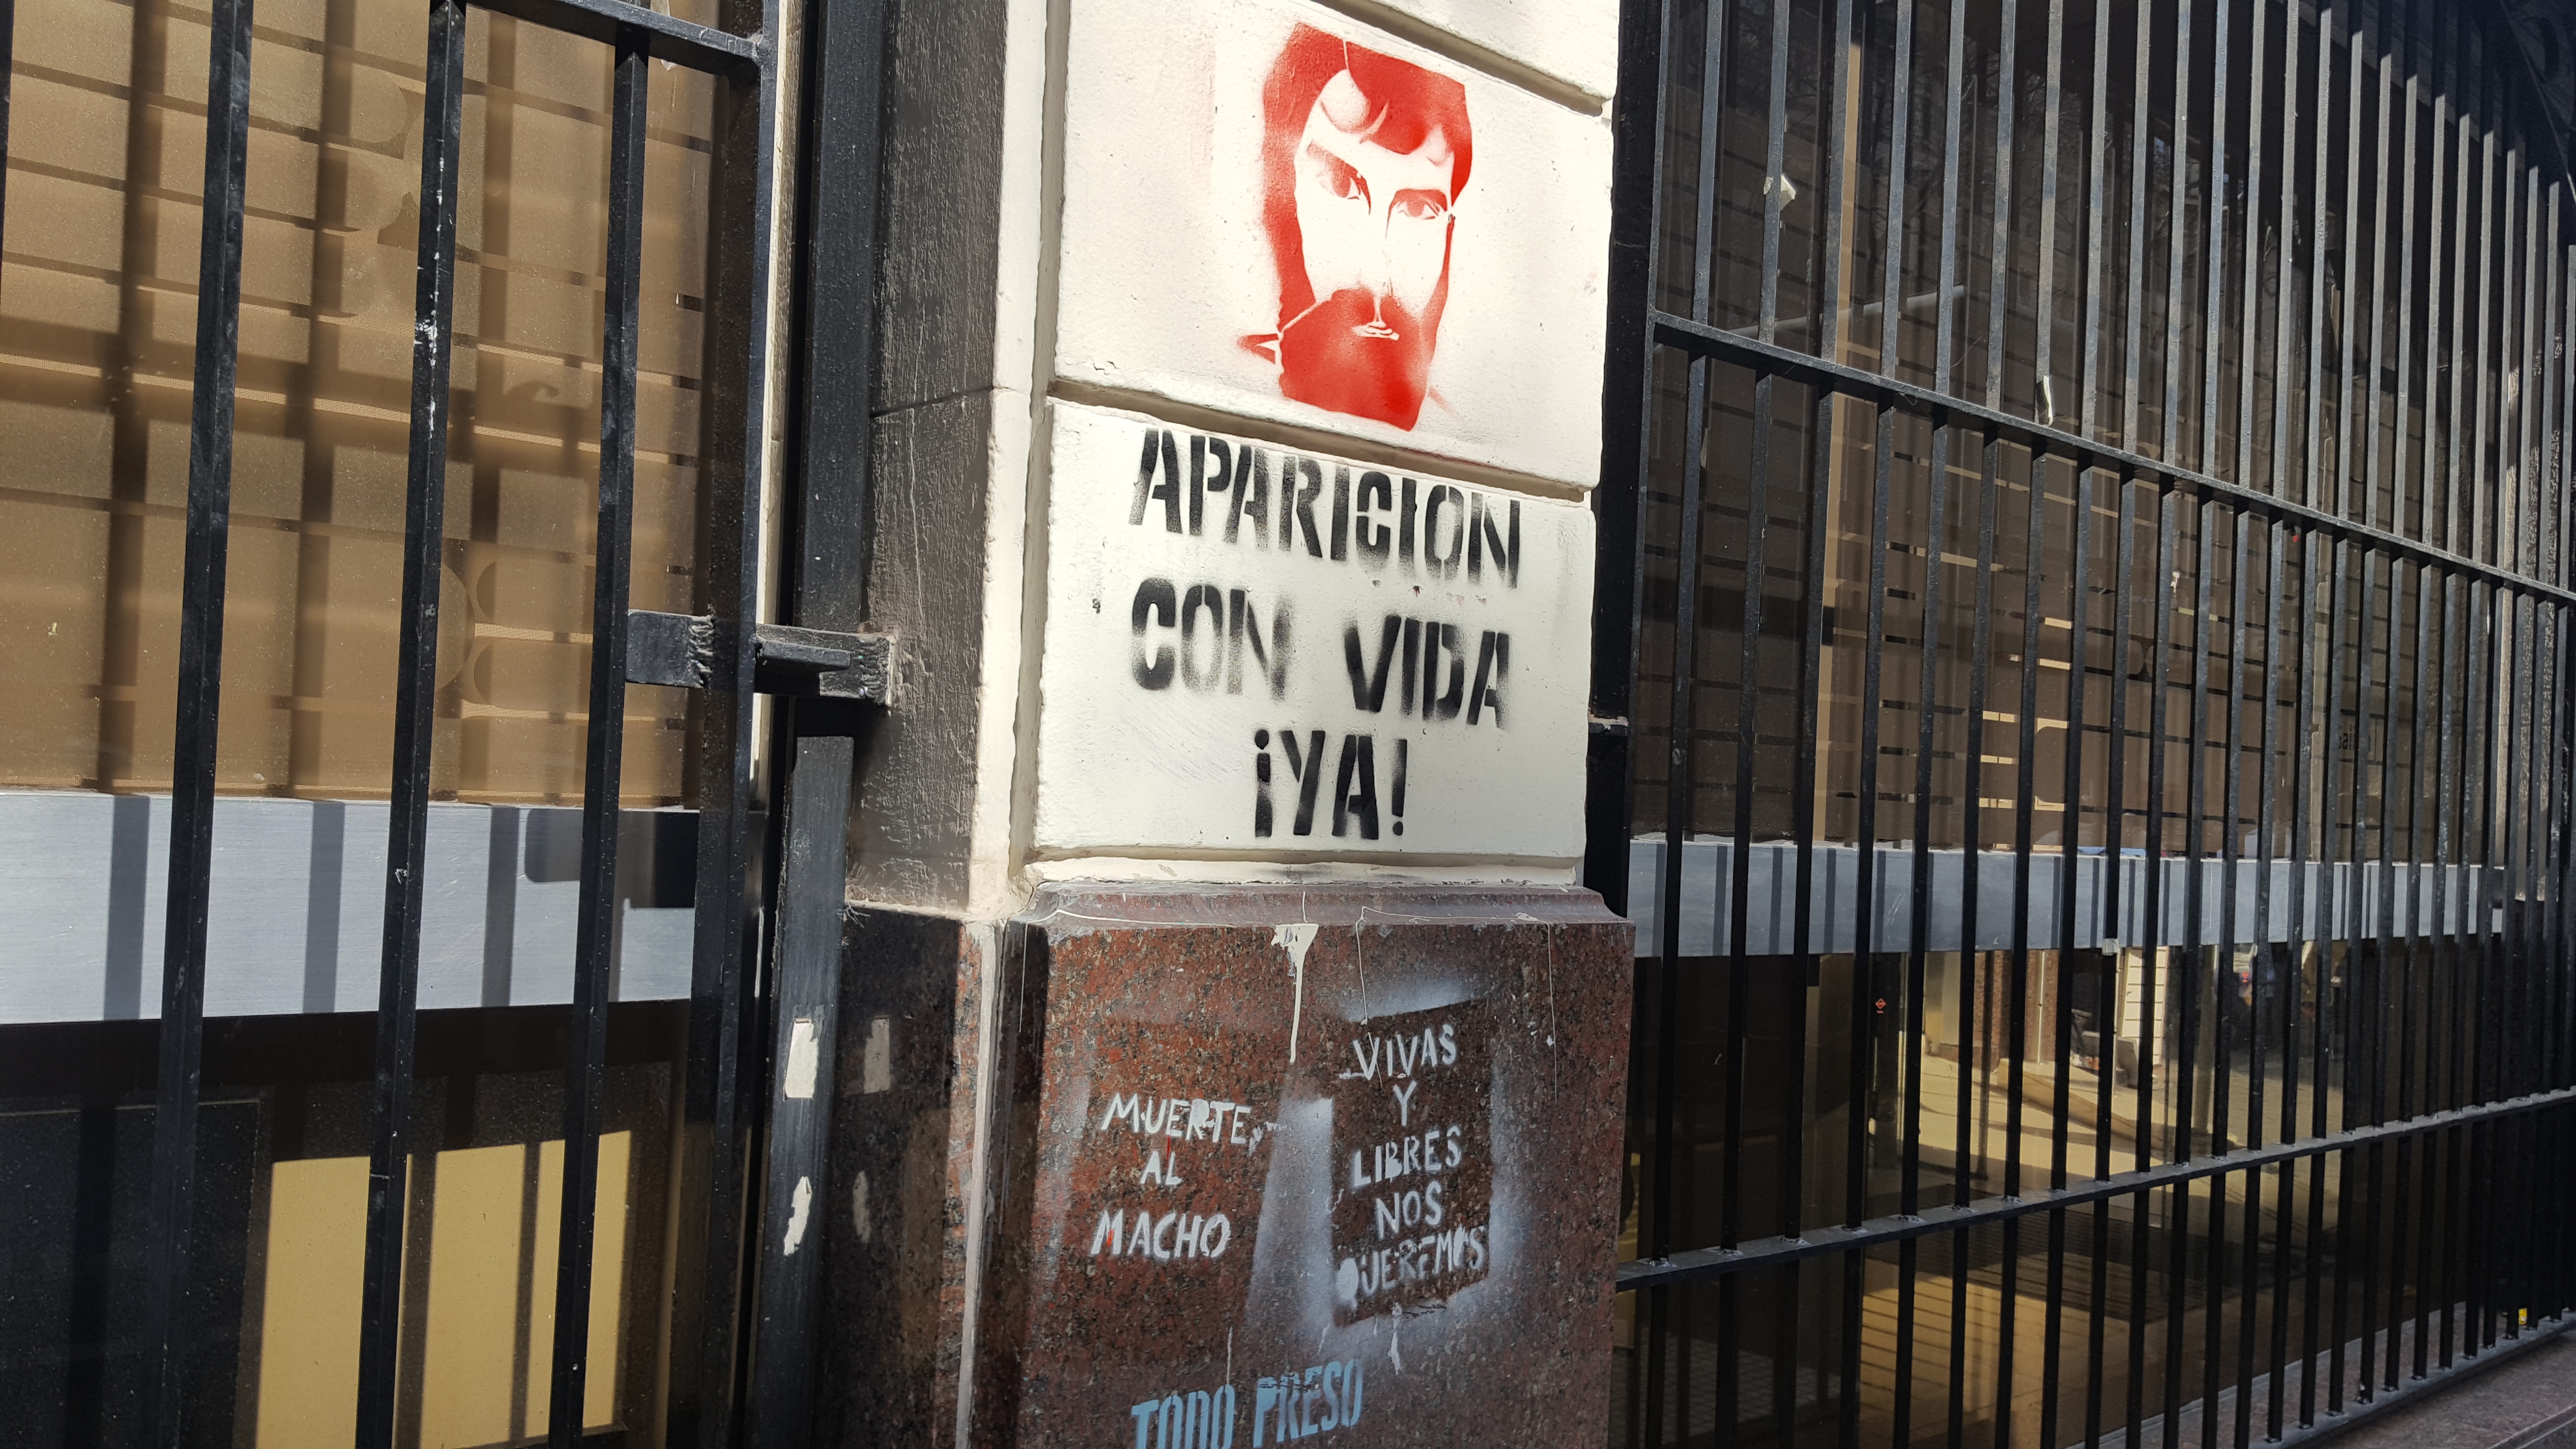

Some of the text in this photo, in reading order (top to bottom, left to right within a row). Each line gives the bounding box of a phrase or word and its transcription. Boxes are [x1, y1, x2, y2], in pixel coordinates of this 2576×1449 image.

[1128, 427, 1520, 589] APARICION
[1130, 578, 1512, 729] CON VIDA
[1352, 1024, 1457, 1081] VIVAS
[1392, 1080, 1417, 1127] Y
[1140, 1150, 1183, 1186] AL
[1353, 1126, 1462, 1188] LIBRES
[1090, 1208, 1232, 1259] MACHO
[1375, 1180, 1442, 1240] NOS
[1253, 1360, 1363, 1449] PRESO
